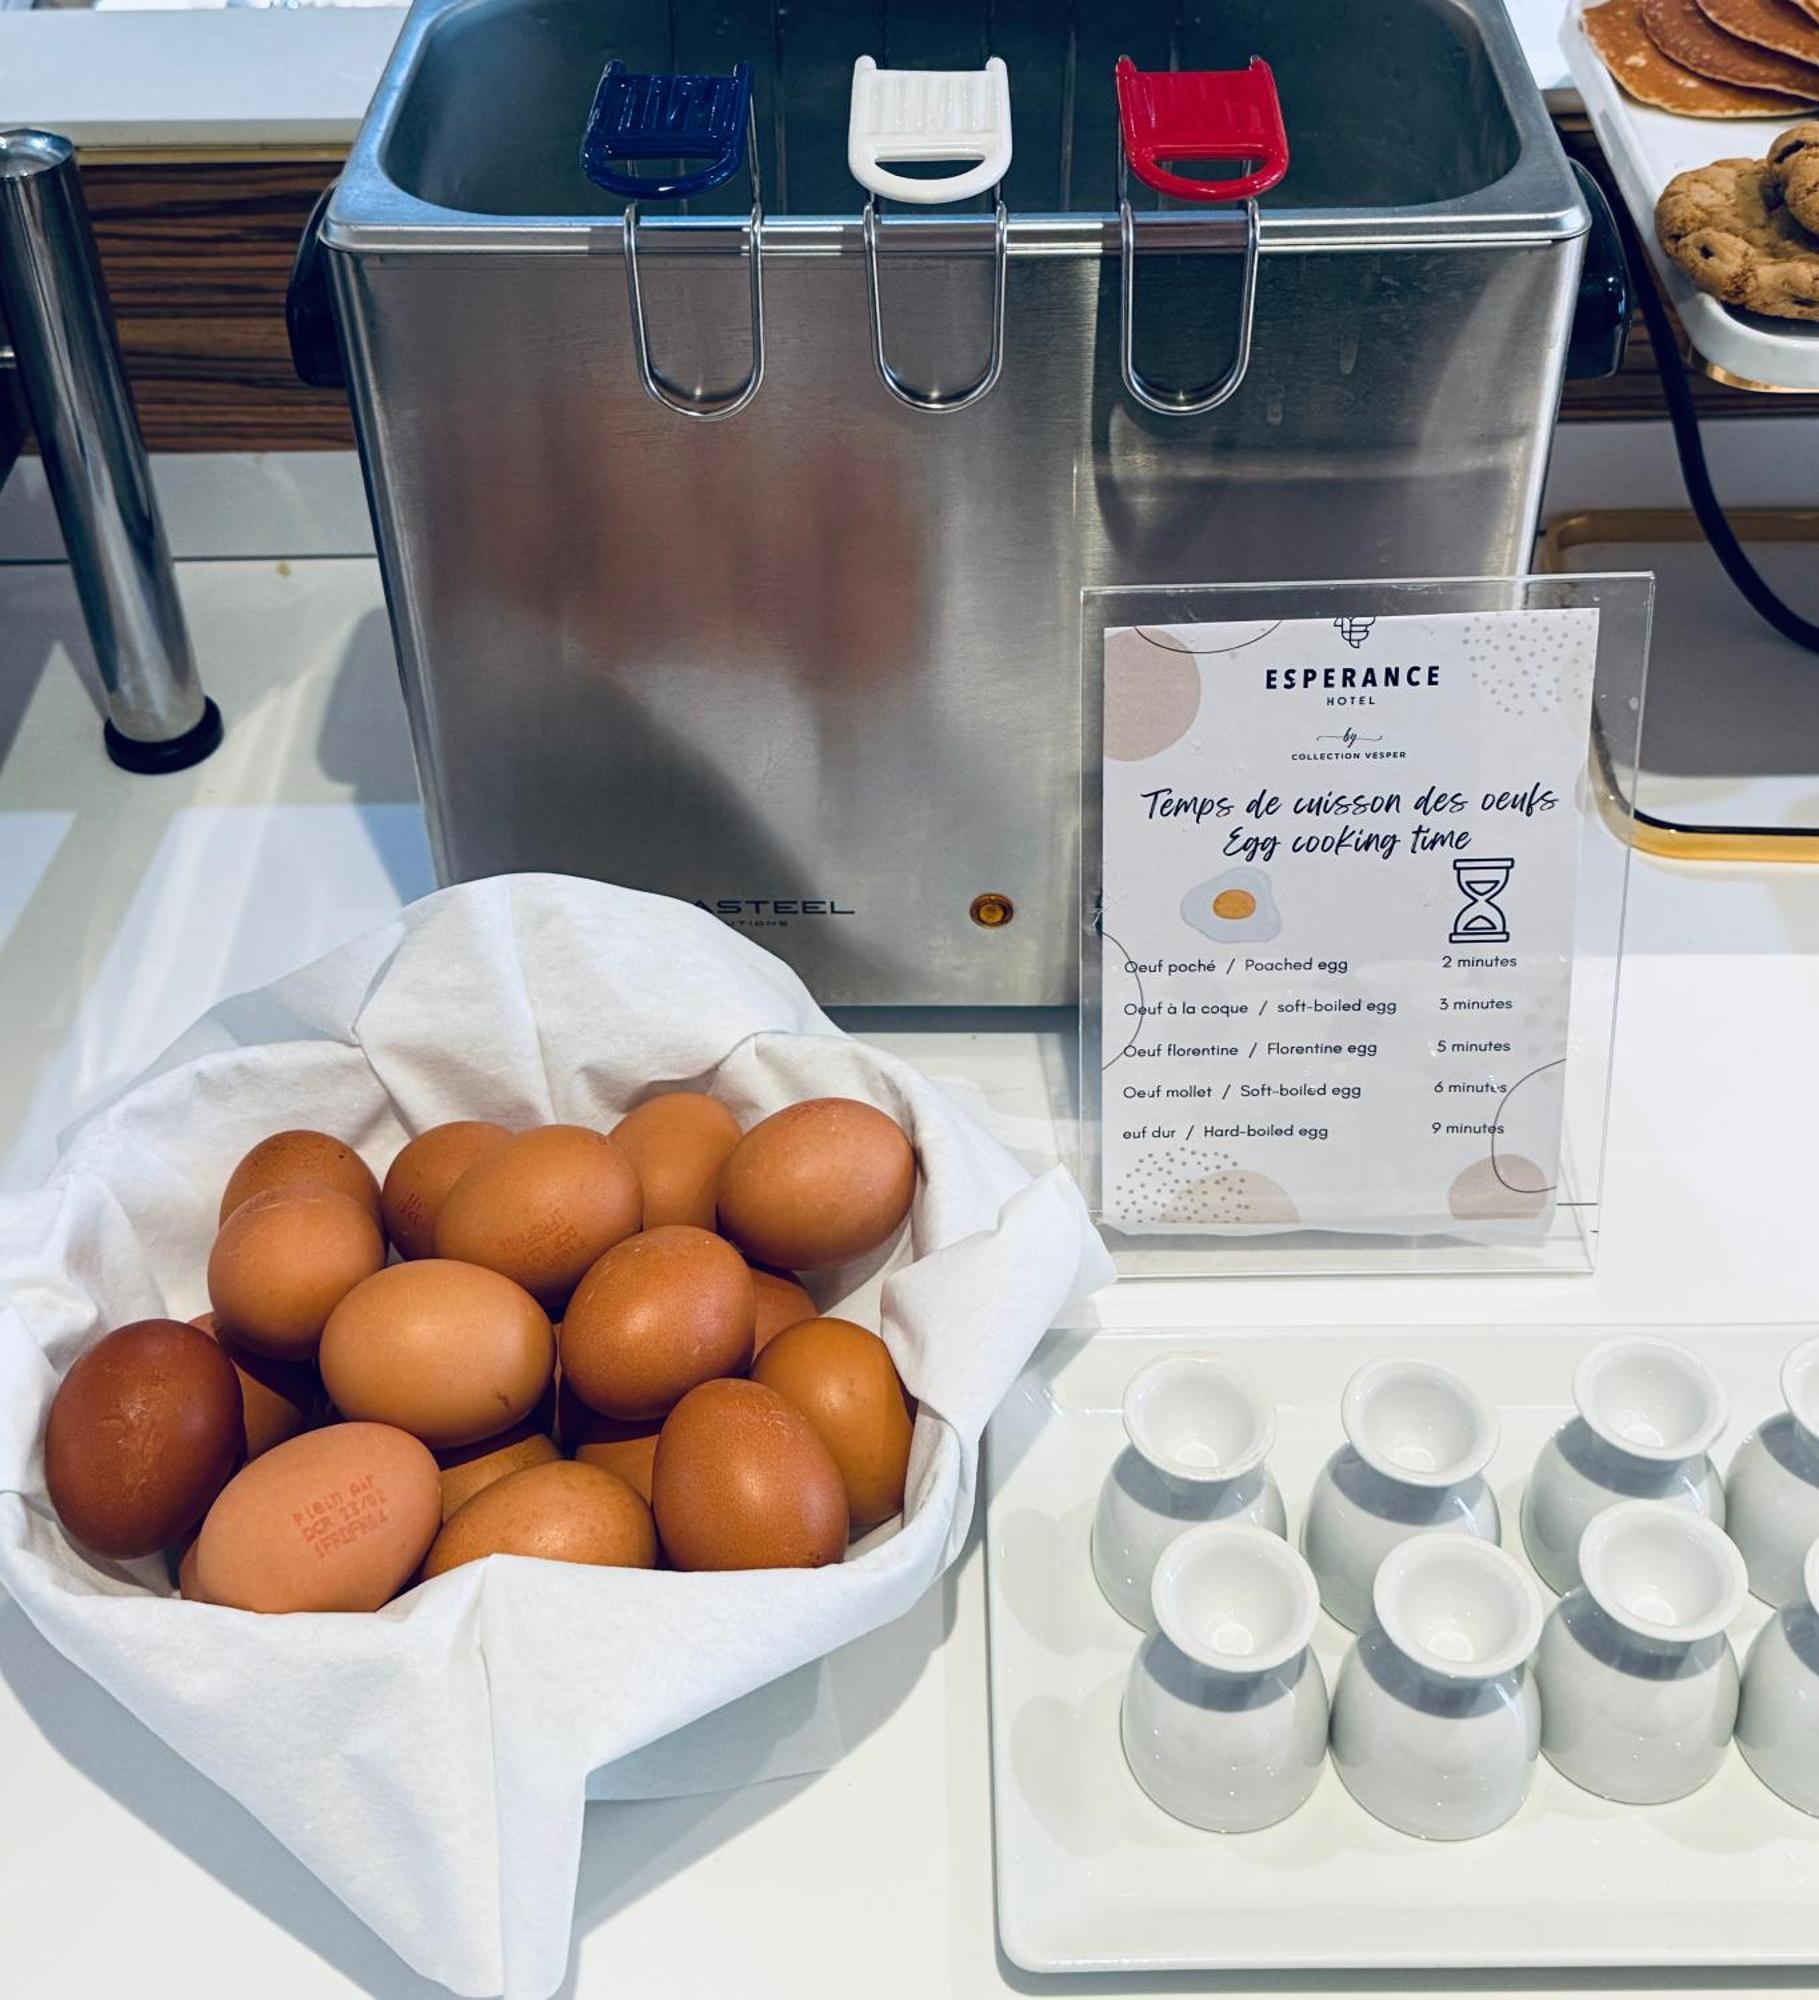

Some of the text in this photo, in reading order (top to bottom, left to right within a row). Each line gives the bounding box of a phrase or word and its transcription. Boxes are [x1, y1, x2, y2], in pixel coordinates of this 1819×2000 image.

[1265, 664, 1440, 691] ESPERANCE
[1326, 695, 1376, 707] HOTEL
[1342, 726, 1358, 748] by
[1291, 751, 1407, 761] COLLECTION VESPER
[1139, 781, 1560, 825] Temps de cuisson des oeufs
[1222, 824, 1473, 863] Egg cooking time
[1123, 957, 1348, 977] Oeuf poché / Poached egg
[1441, 955, 1518, 969] 2 minutes
[1123, 999, 1397, 1019] Oeuf à la coque / soft-boiled egg
[1439, 997, 1513, 1011] 3 minutes
[1122, 1041, 1378, 1059] Oeuf florentine / Florentine egg
[1436, 1039, 1512, 1053] 5 minutes
[1122, 1082, 1362, 1100] Oeuf mollet / Soft-boiled egg
[1433, 1080, 1508, 1094] 6 minutes
[1122, 1123, 1329, 1141] euf dur / Hard-boiled egg
[1431, 1121, 1505, 1136] 9 minutes
